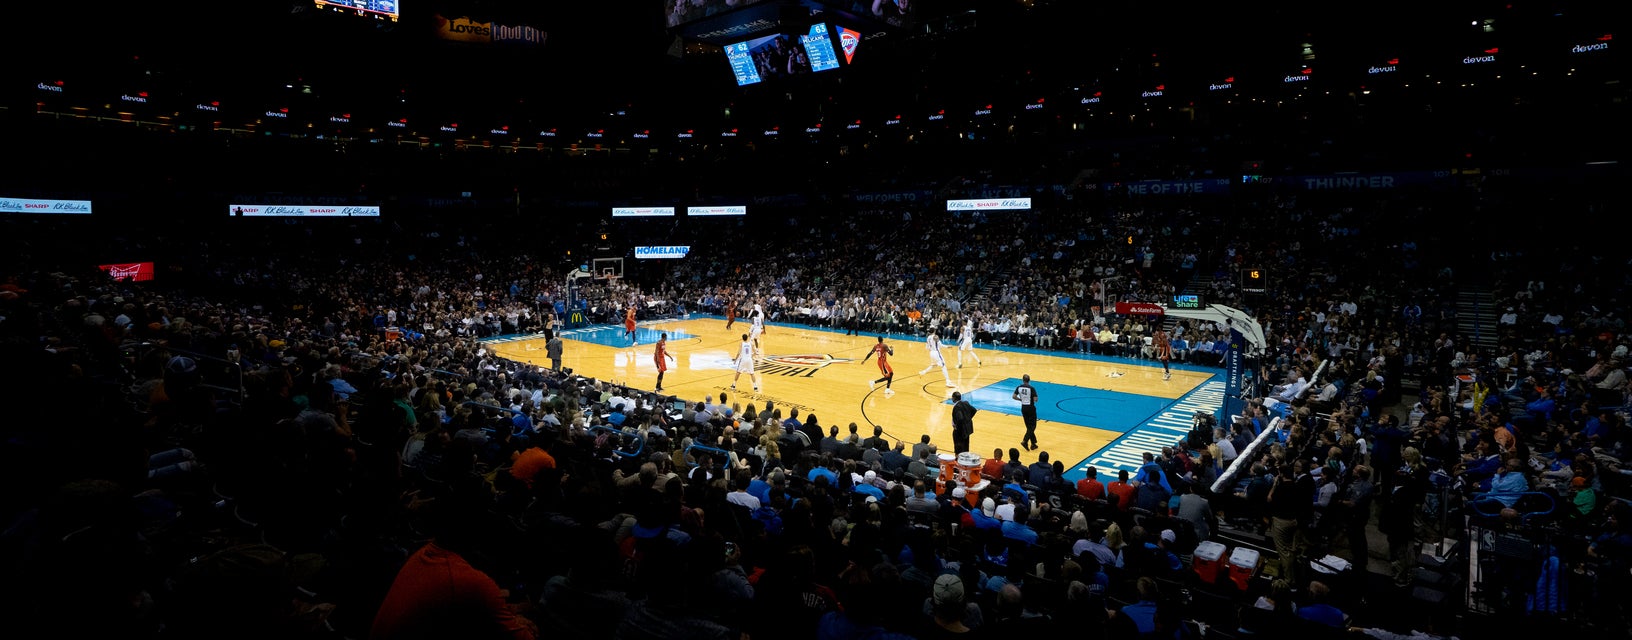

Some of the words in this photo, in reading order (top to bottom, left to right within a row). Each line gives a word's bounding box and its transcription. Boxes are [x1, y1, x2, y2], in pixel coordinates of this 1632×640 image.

[448, 20, 490, 36] Loves
[737, 43, 748, 52] 62
[1572, 43, 1608, 53] devon
[1462, 56, 1496, 64] devon
[1368, 66, 1396, 74] devon
[37, 83, 63, 93] devon
[121, 95, 147, 103] devon
[196, 104, 218, 112] devon
[1150, 184, 1170, 193] OF
[1173, 183, 1203, 193] THE
[1304, 176, 1395, 190] THUNDER
[856, 194, 902, 203] WELCOME
[903, 193, 916, 201] TO
[636, 246, 689, 255] HOMELAND
[1230, 350, 1238, 388] DRAFTKINGS
[1147, 411, 1199, 433] CITY
[1079, 429, 1186, 479] THUNDER
